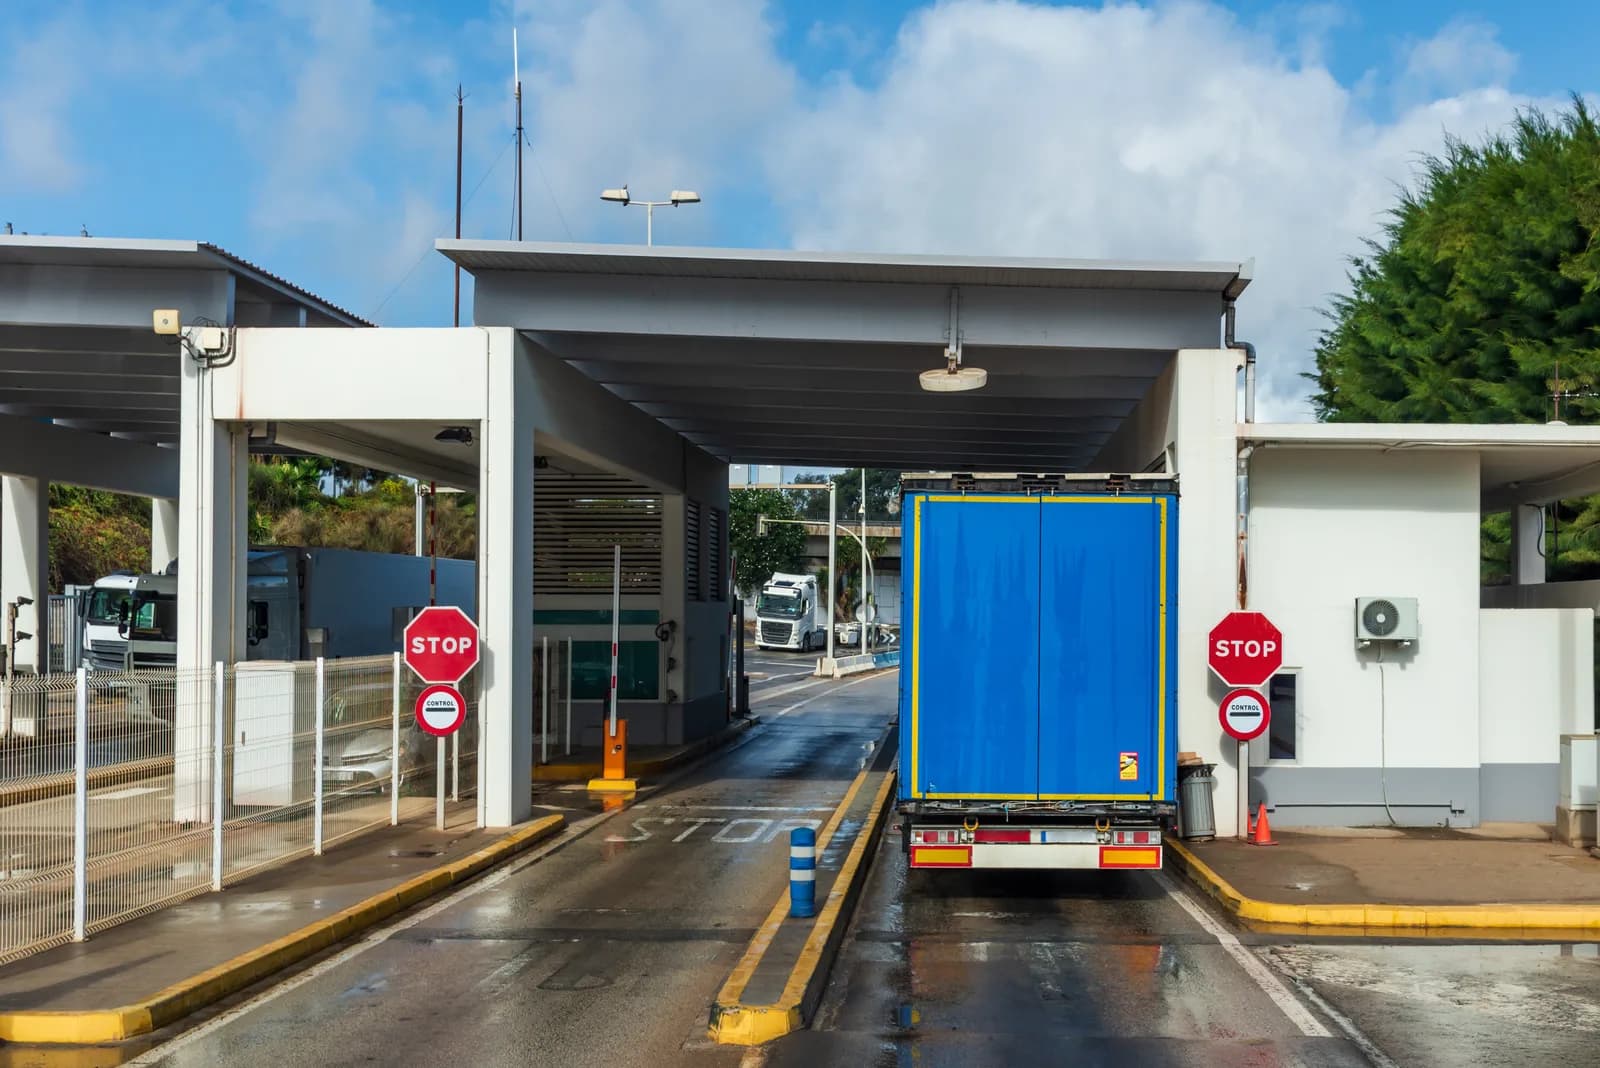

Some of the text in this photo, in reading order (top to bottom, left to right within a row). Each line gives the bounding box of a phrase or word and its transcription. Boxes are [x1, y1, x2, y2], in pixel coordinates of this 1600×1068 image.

[411, 636, 473, 654] STOP
[1215, 639, 1277, 658] STOP
[604, 817, 823, 843] STOP
